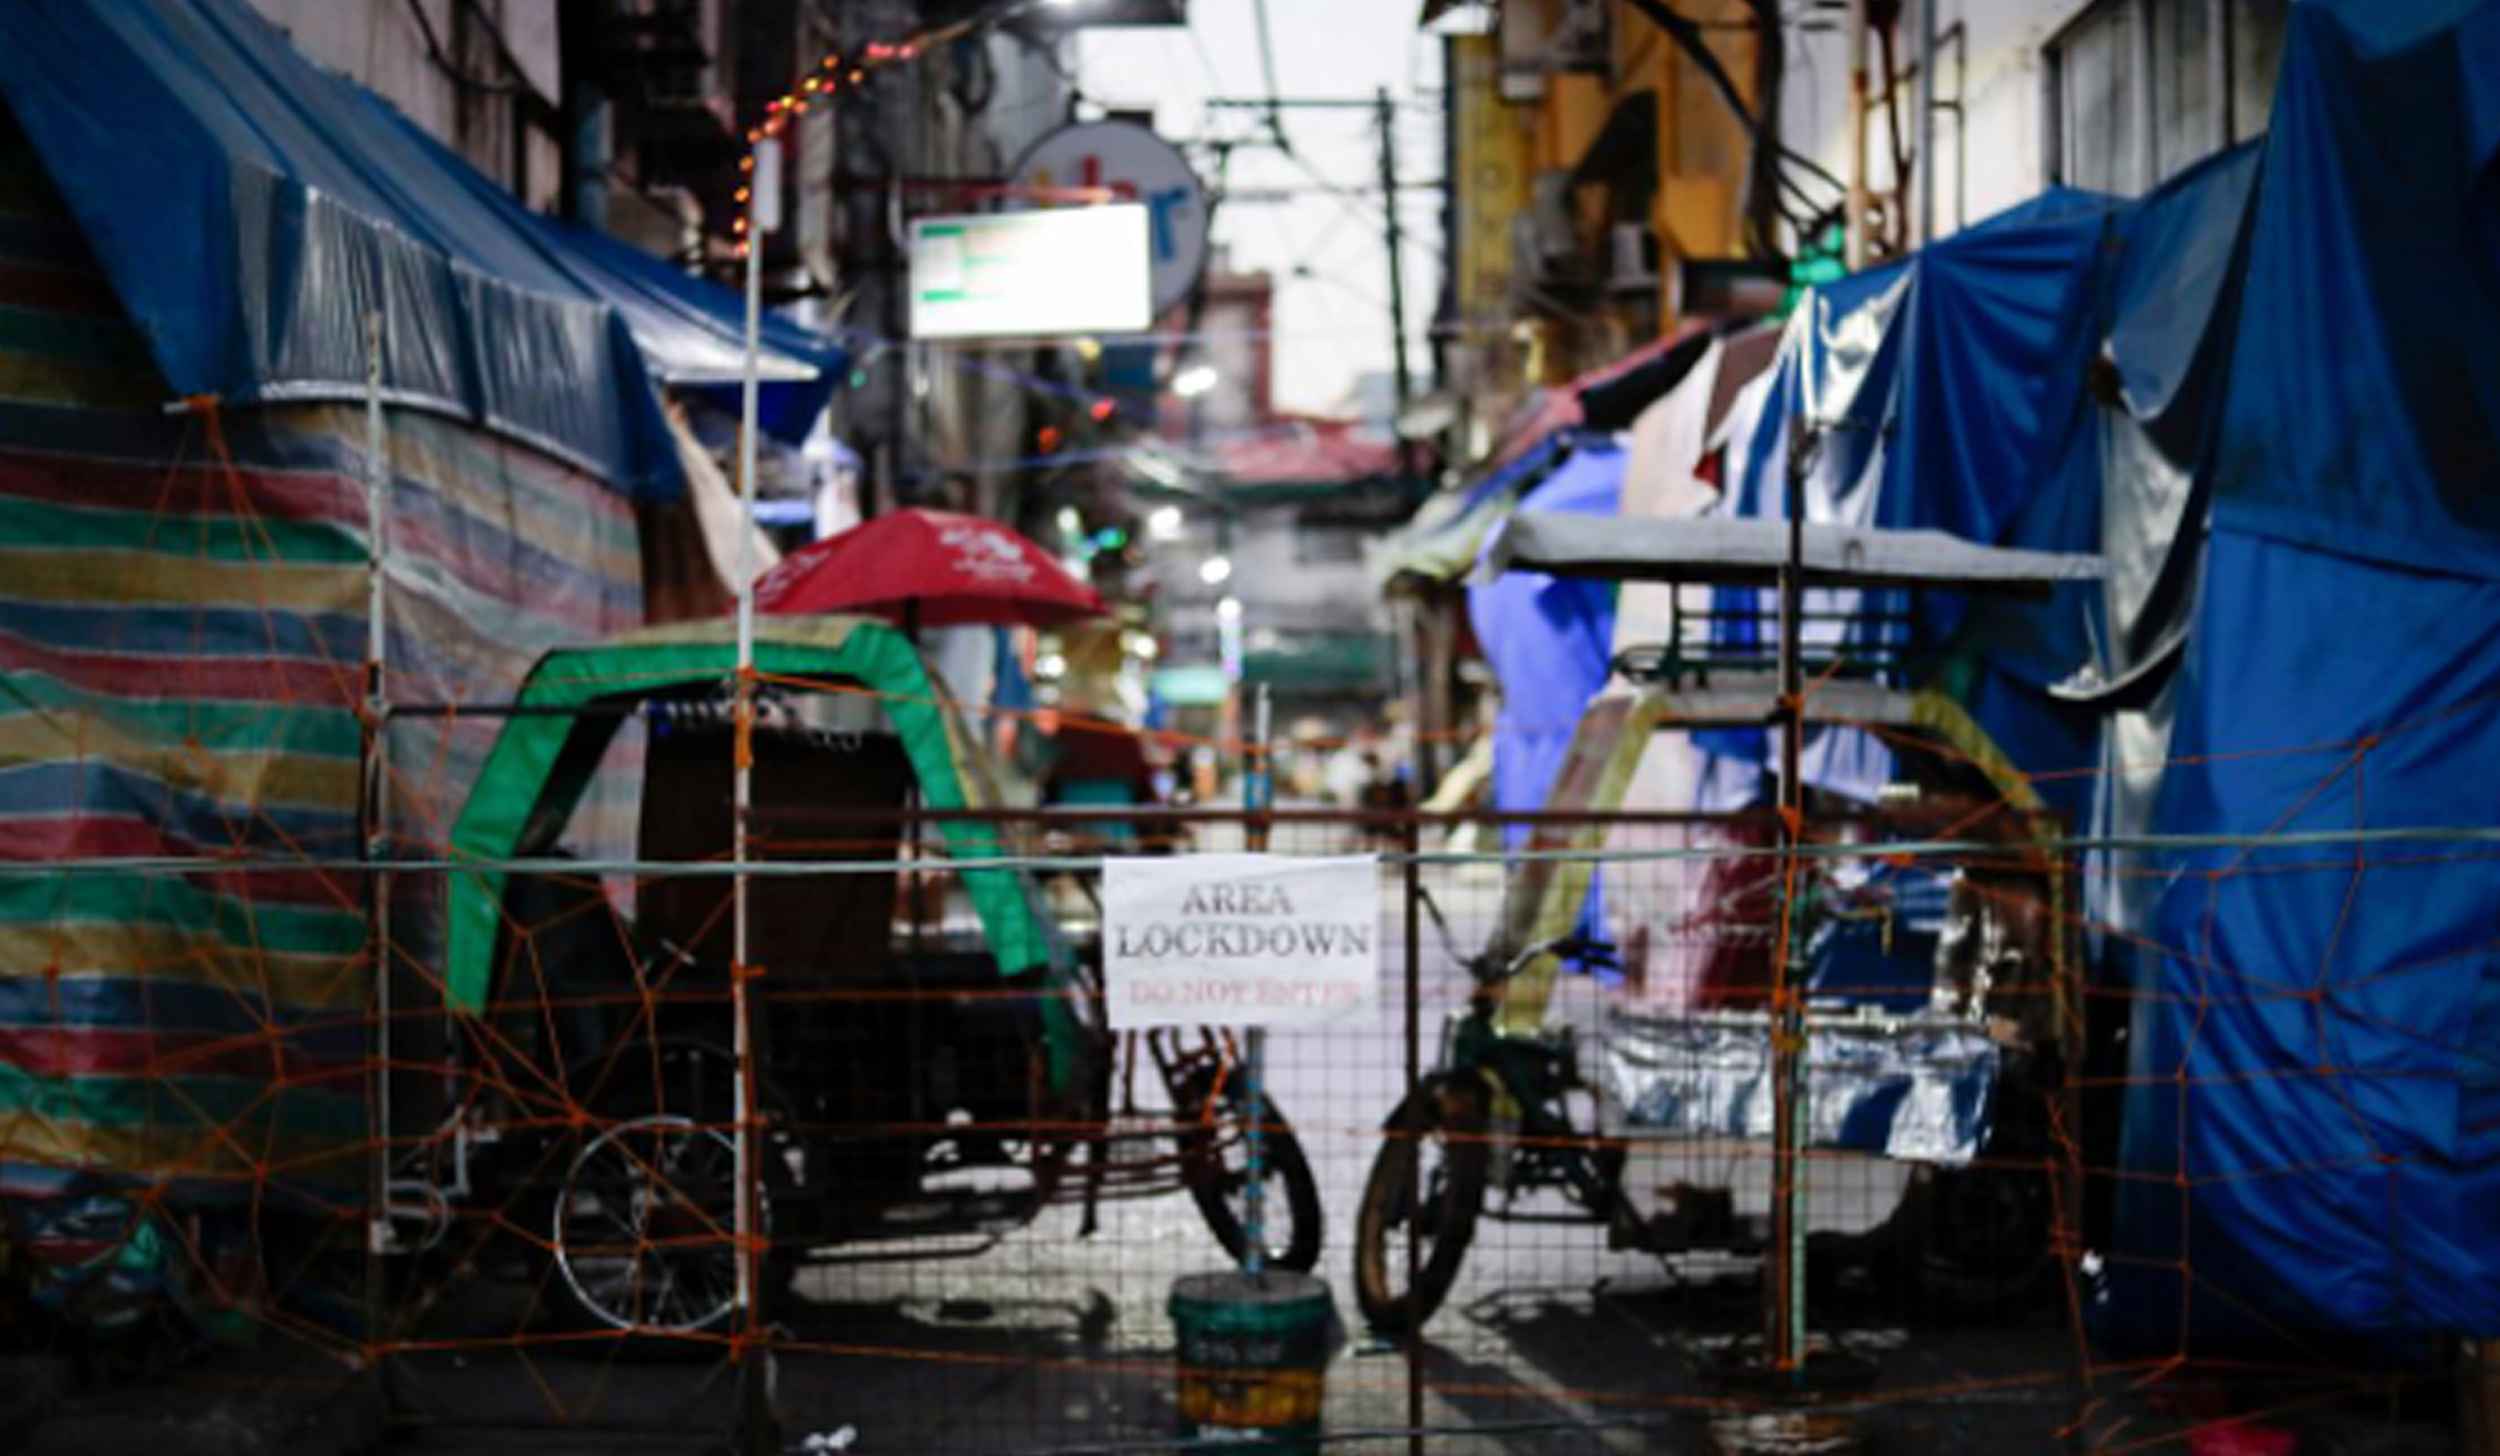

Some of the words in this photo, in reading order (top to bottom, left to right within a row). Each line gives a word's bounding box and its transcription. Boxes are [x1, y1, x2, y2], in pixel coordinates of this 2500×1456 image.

[1182, 883, 1294, 915] AREA
[1115, 921, 1370, 957] LOCKDOWN
[1129, 978, 1174, 1004] DO
[1183, 978, 1249, 1004] NOT
